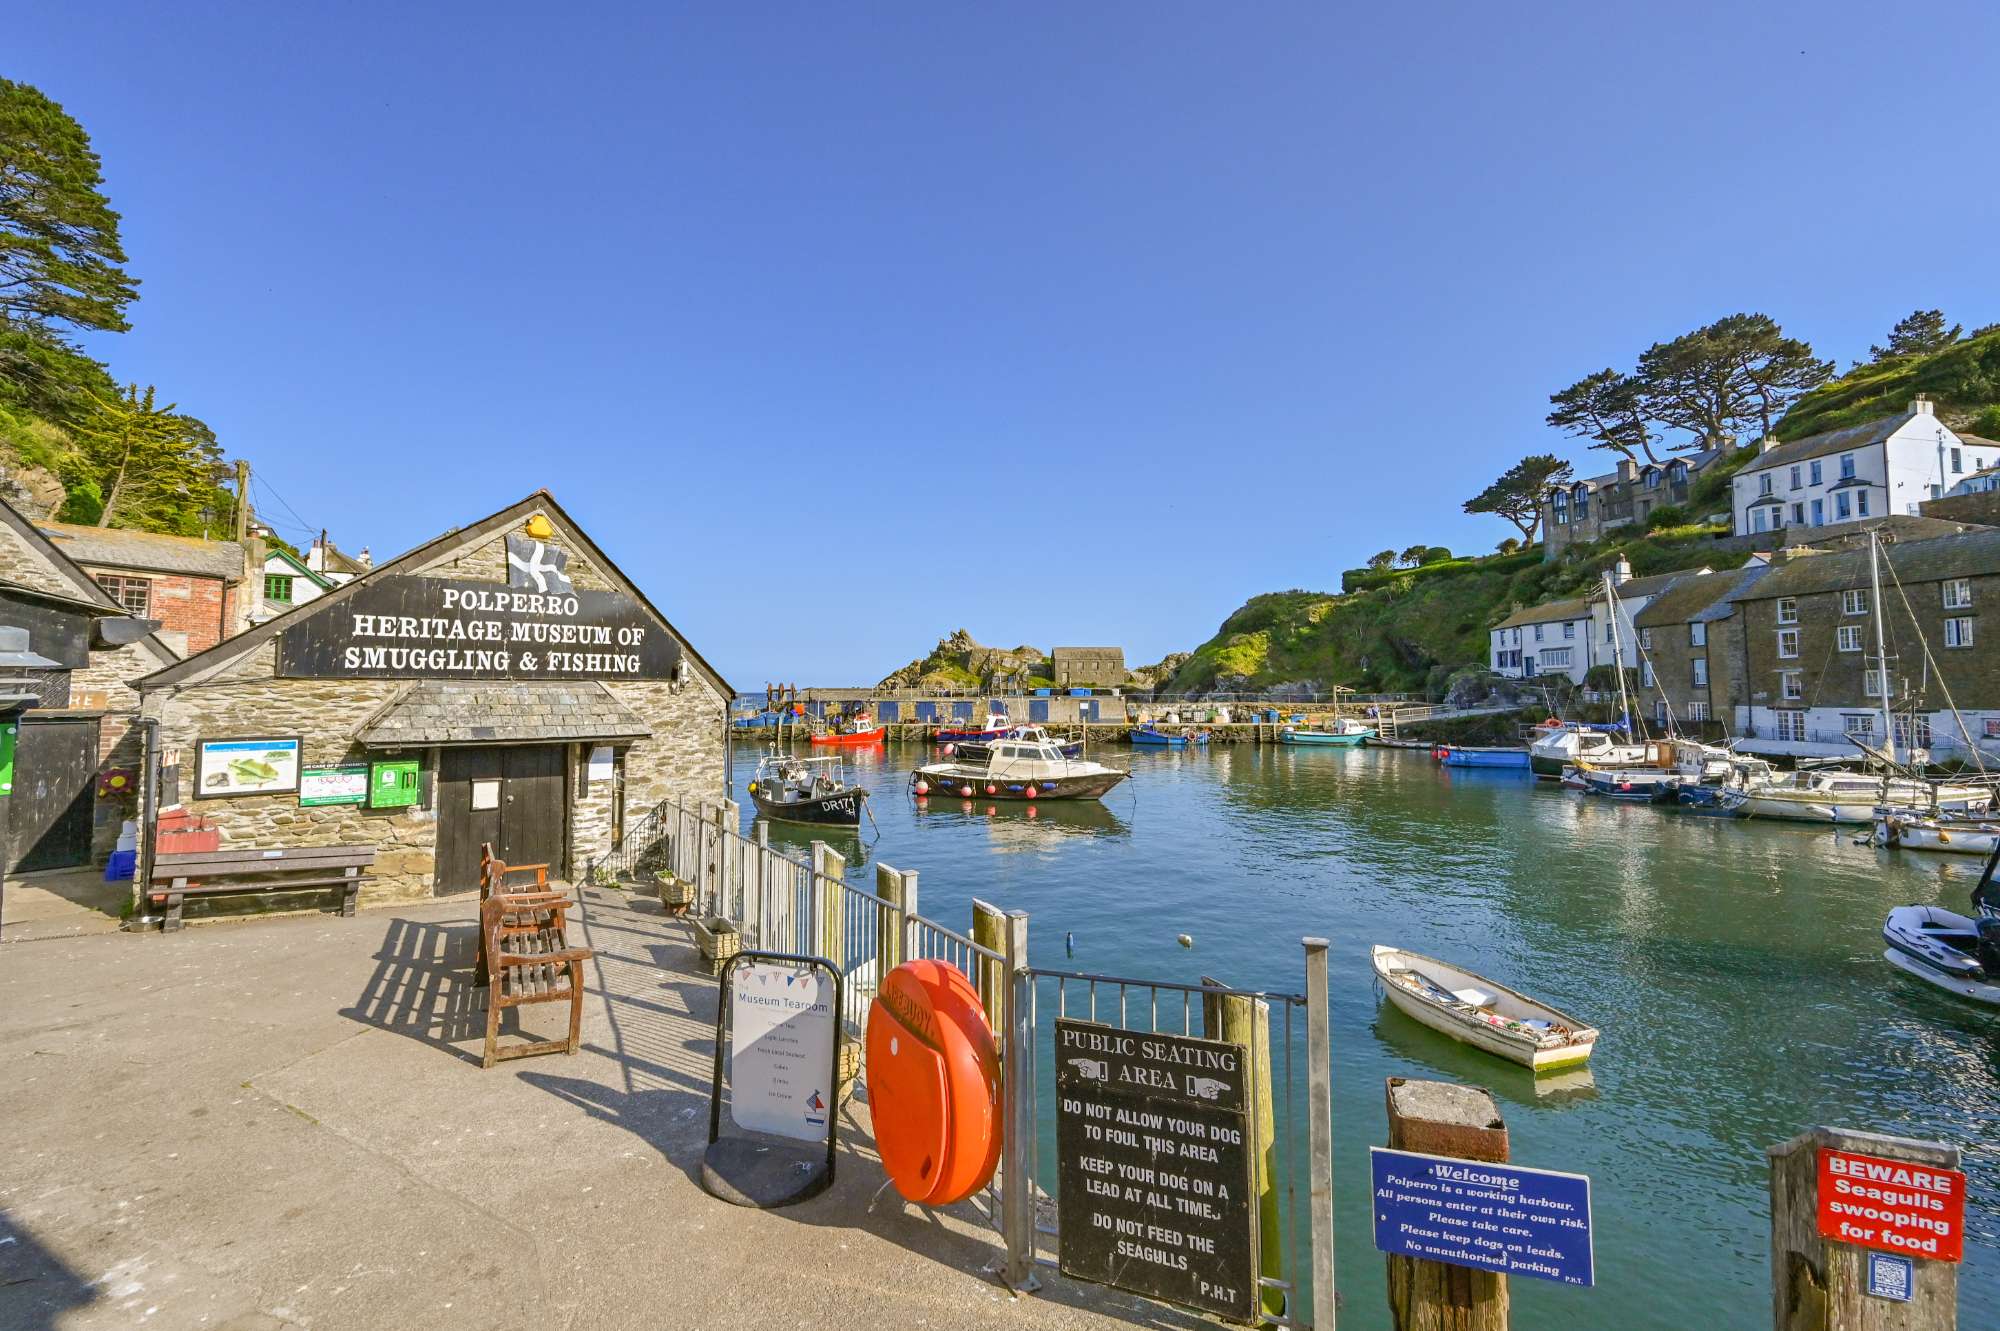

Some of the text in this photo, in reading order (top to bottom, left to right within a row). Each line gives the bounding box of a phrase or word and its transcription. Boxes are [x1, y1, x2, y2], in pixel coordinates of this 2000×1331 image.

[443, 588, 579, 616] POLPERRO
[352, 614, 645, 646] HERITAGE MUSEUM OF
[344, 647, 640, 672] SMUGGLING & FISHING
[739, 993, 780, 1006] Museum
[784, 998, 828, 1012] Tearoom
[1062, 1030, 1236, 1072] PUBLIC SEATING
[1118, 1064, 1178, 1090] AREA
[1064, 1099, 1241, 1145] DO NOT ALLOW YOUR DOG
[1084, 1124, 1219, 1163] TO FOUL THIS AREA
[1080, 1156, 1229, 1200] KEEP YOUR DOG ON A
[1435, 1165, 1520, 1188] Welcome
[1829, 1157, 1952, 1191] BEWARE
[1086, 1178, 1120, 1198] LEAD
[1124, 1187, 1142, 1203] AT
[1146, 1192, 1172, 1210] ALL
[1387, 1174, 1574, 1211] Polperro is a working harbour.
[1835, 1179, 1944, 1211] Seagulls
[1377, 1188, 1587, 1230] All persons enter at their own risk.
[1429, 1212, 1532, 1237] Please take care.
[1830, 1202, 1950, 1236] swooping
[1093, 1212, 1215, 1254] DO NOT FEED THE
[1400, 1223, 1565, 1260] Please keep dogs on leads.
[1839, 1222, 1937, 1253] for food
[1117, 1240, 1188, 1271] SEAGULLS
[1406, 1240, 1560, 1277] No unauthorised parking
[1201, 1281, 1236, 1303] P.H.T
